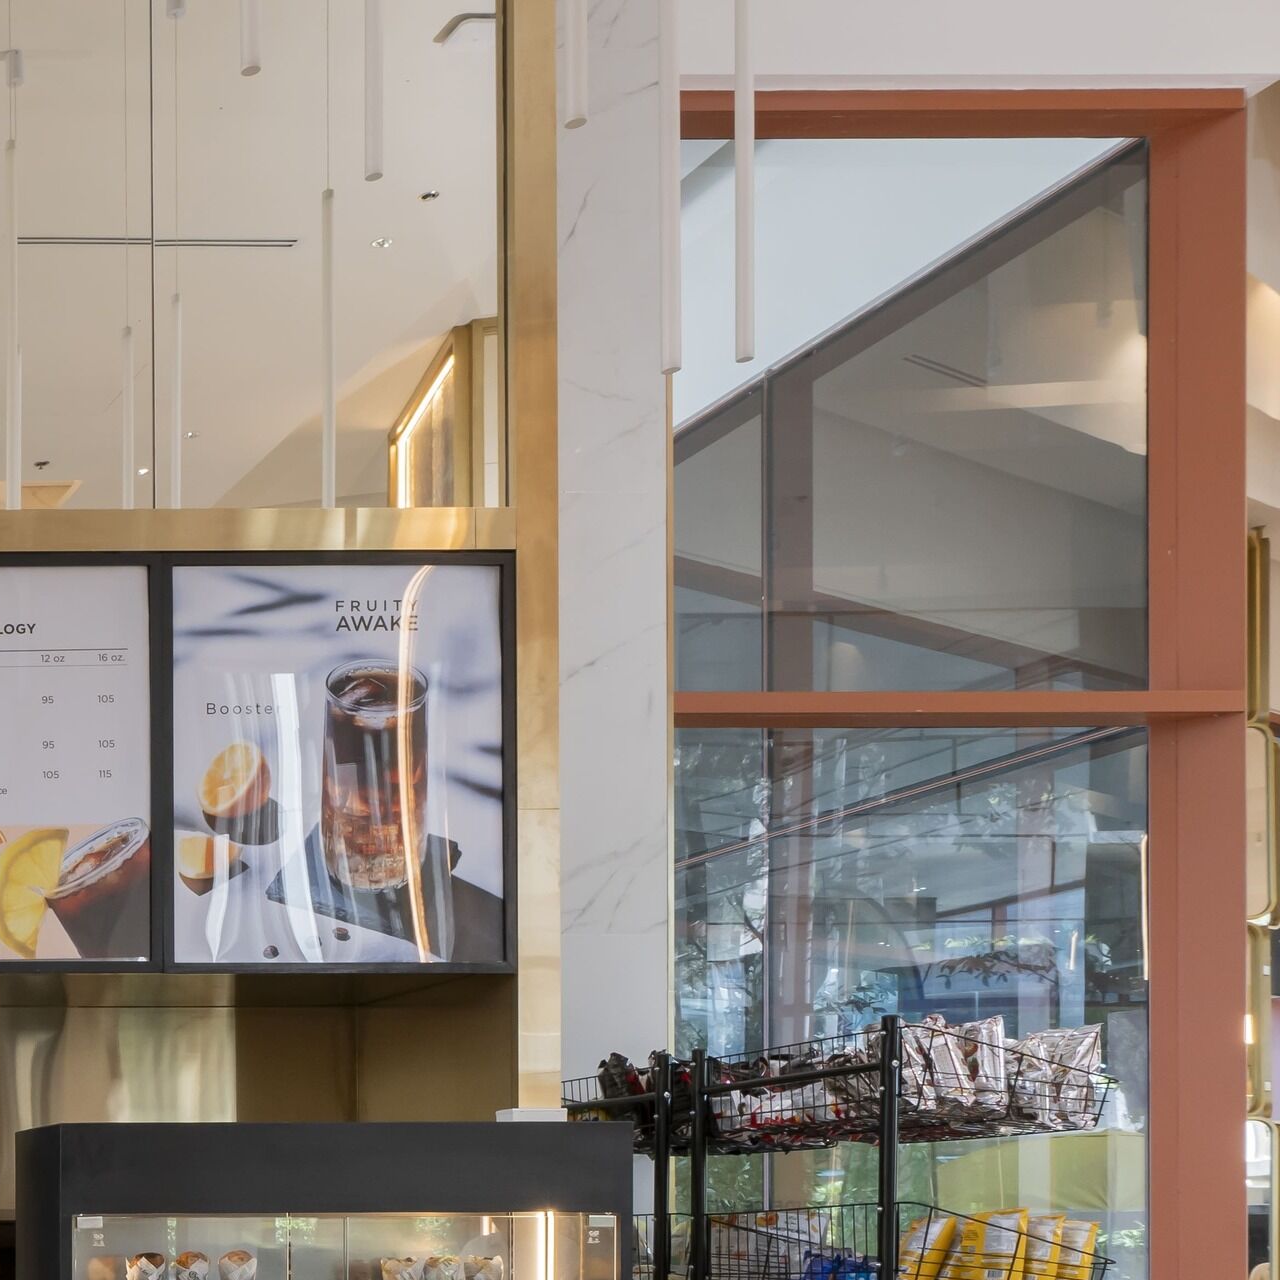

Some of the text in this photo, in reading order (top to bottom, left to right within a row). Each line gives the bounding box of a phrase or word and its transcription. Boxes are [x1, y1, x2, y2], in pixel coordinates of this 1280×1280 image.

[336, 615, 419, 632] AWAKE
[41, 655, 50, 663] 12
[98, 654, 108, 662] 16
[42, 695, 54, 704] 95
[98, 695, 114, 704] 105
[42, 740, 55, 749] 95
[98, 740, 115, 749] 105
[43, 770, 59, 779] 105
[99, 769, 112, 779] 115
